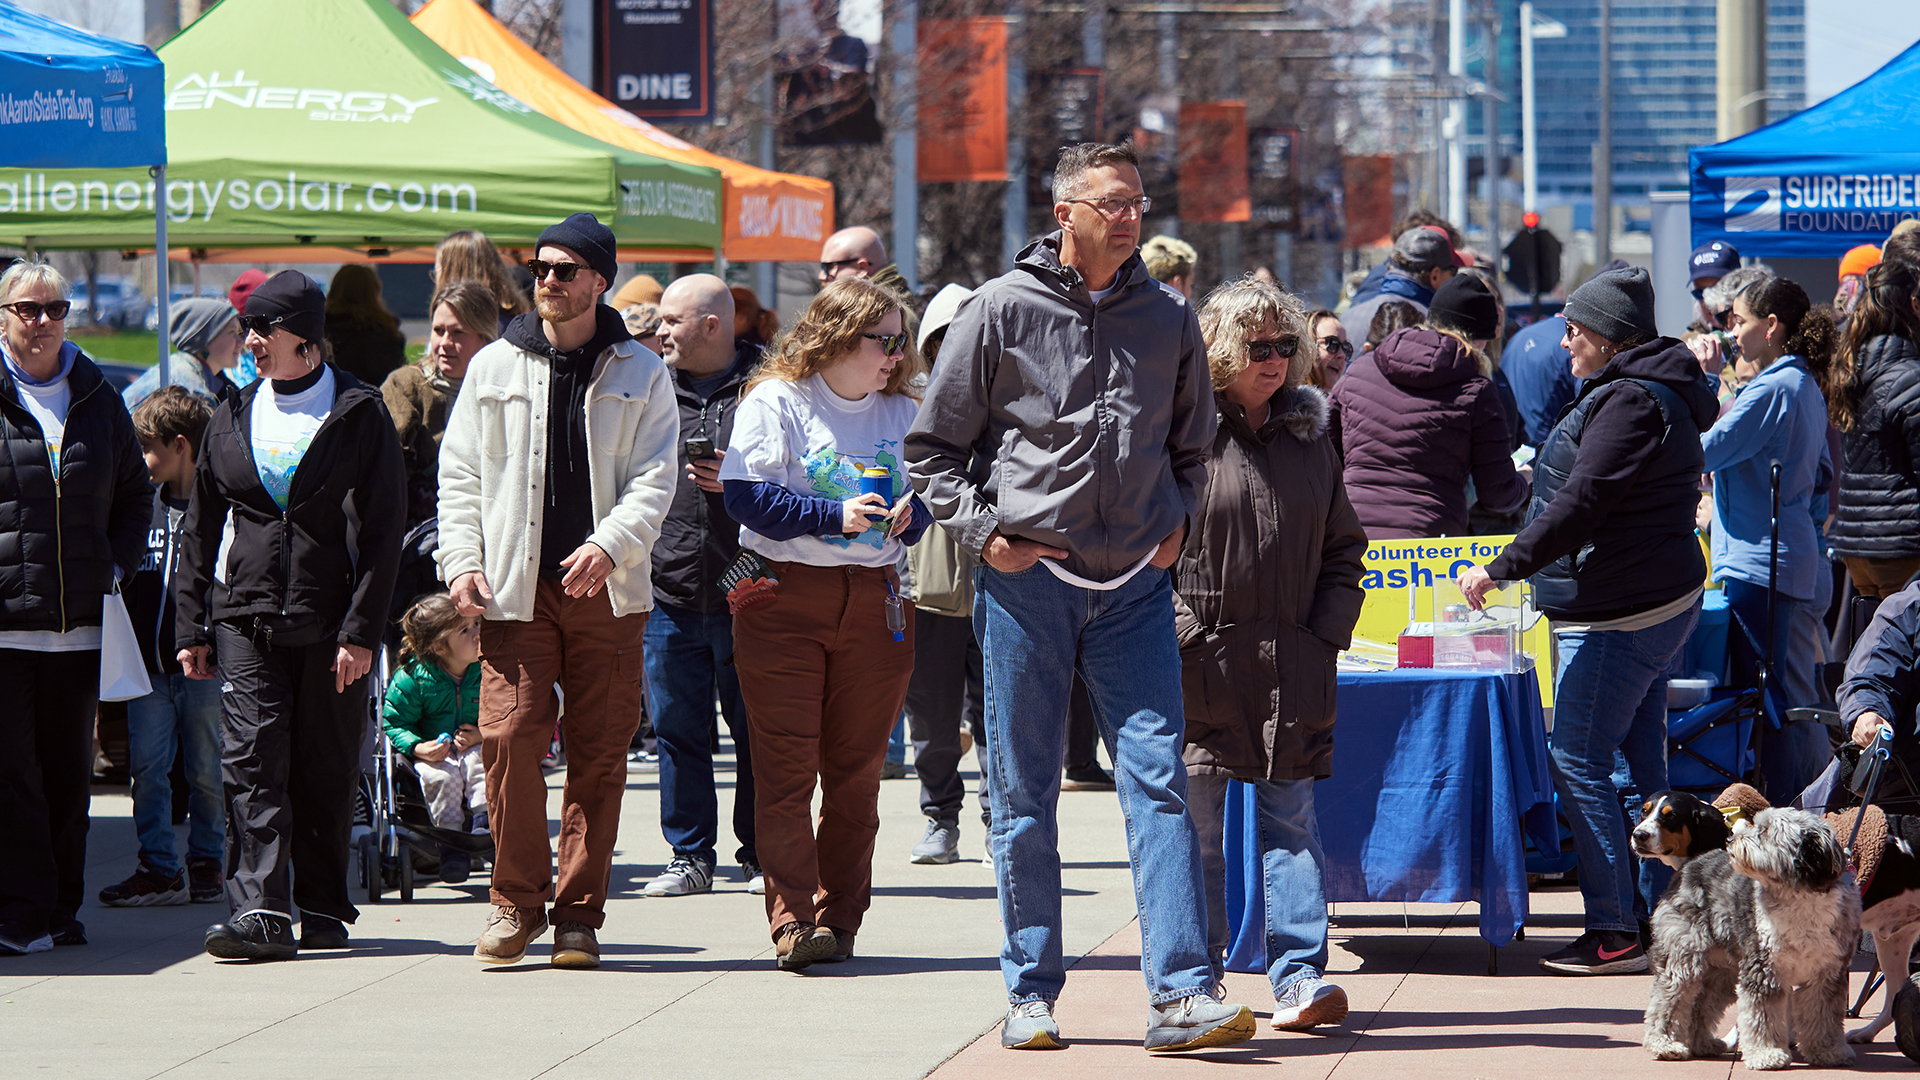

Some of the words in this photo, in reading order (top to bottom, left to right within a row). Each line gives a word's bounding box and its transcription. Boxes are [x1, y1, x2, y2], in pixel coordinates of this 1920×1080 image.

[172, 69, 259, 90] ALL
[617, 73, 692, 100] DINE
[165, 87, 440, 114] ENERGY
[309, 110, 413, 123] SOLAR
[0, 171, 478, 222] allenergysolar.com
[1786, 211, 1920, 231] FOUNDATI
[834, 472, 861, 490] PROTE
[1367, 545, 1463, 561] olunteer
[1470, 542, 1502, 557] for
[732, 565, 746, 579] AFFECT
